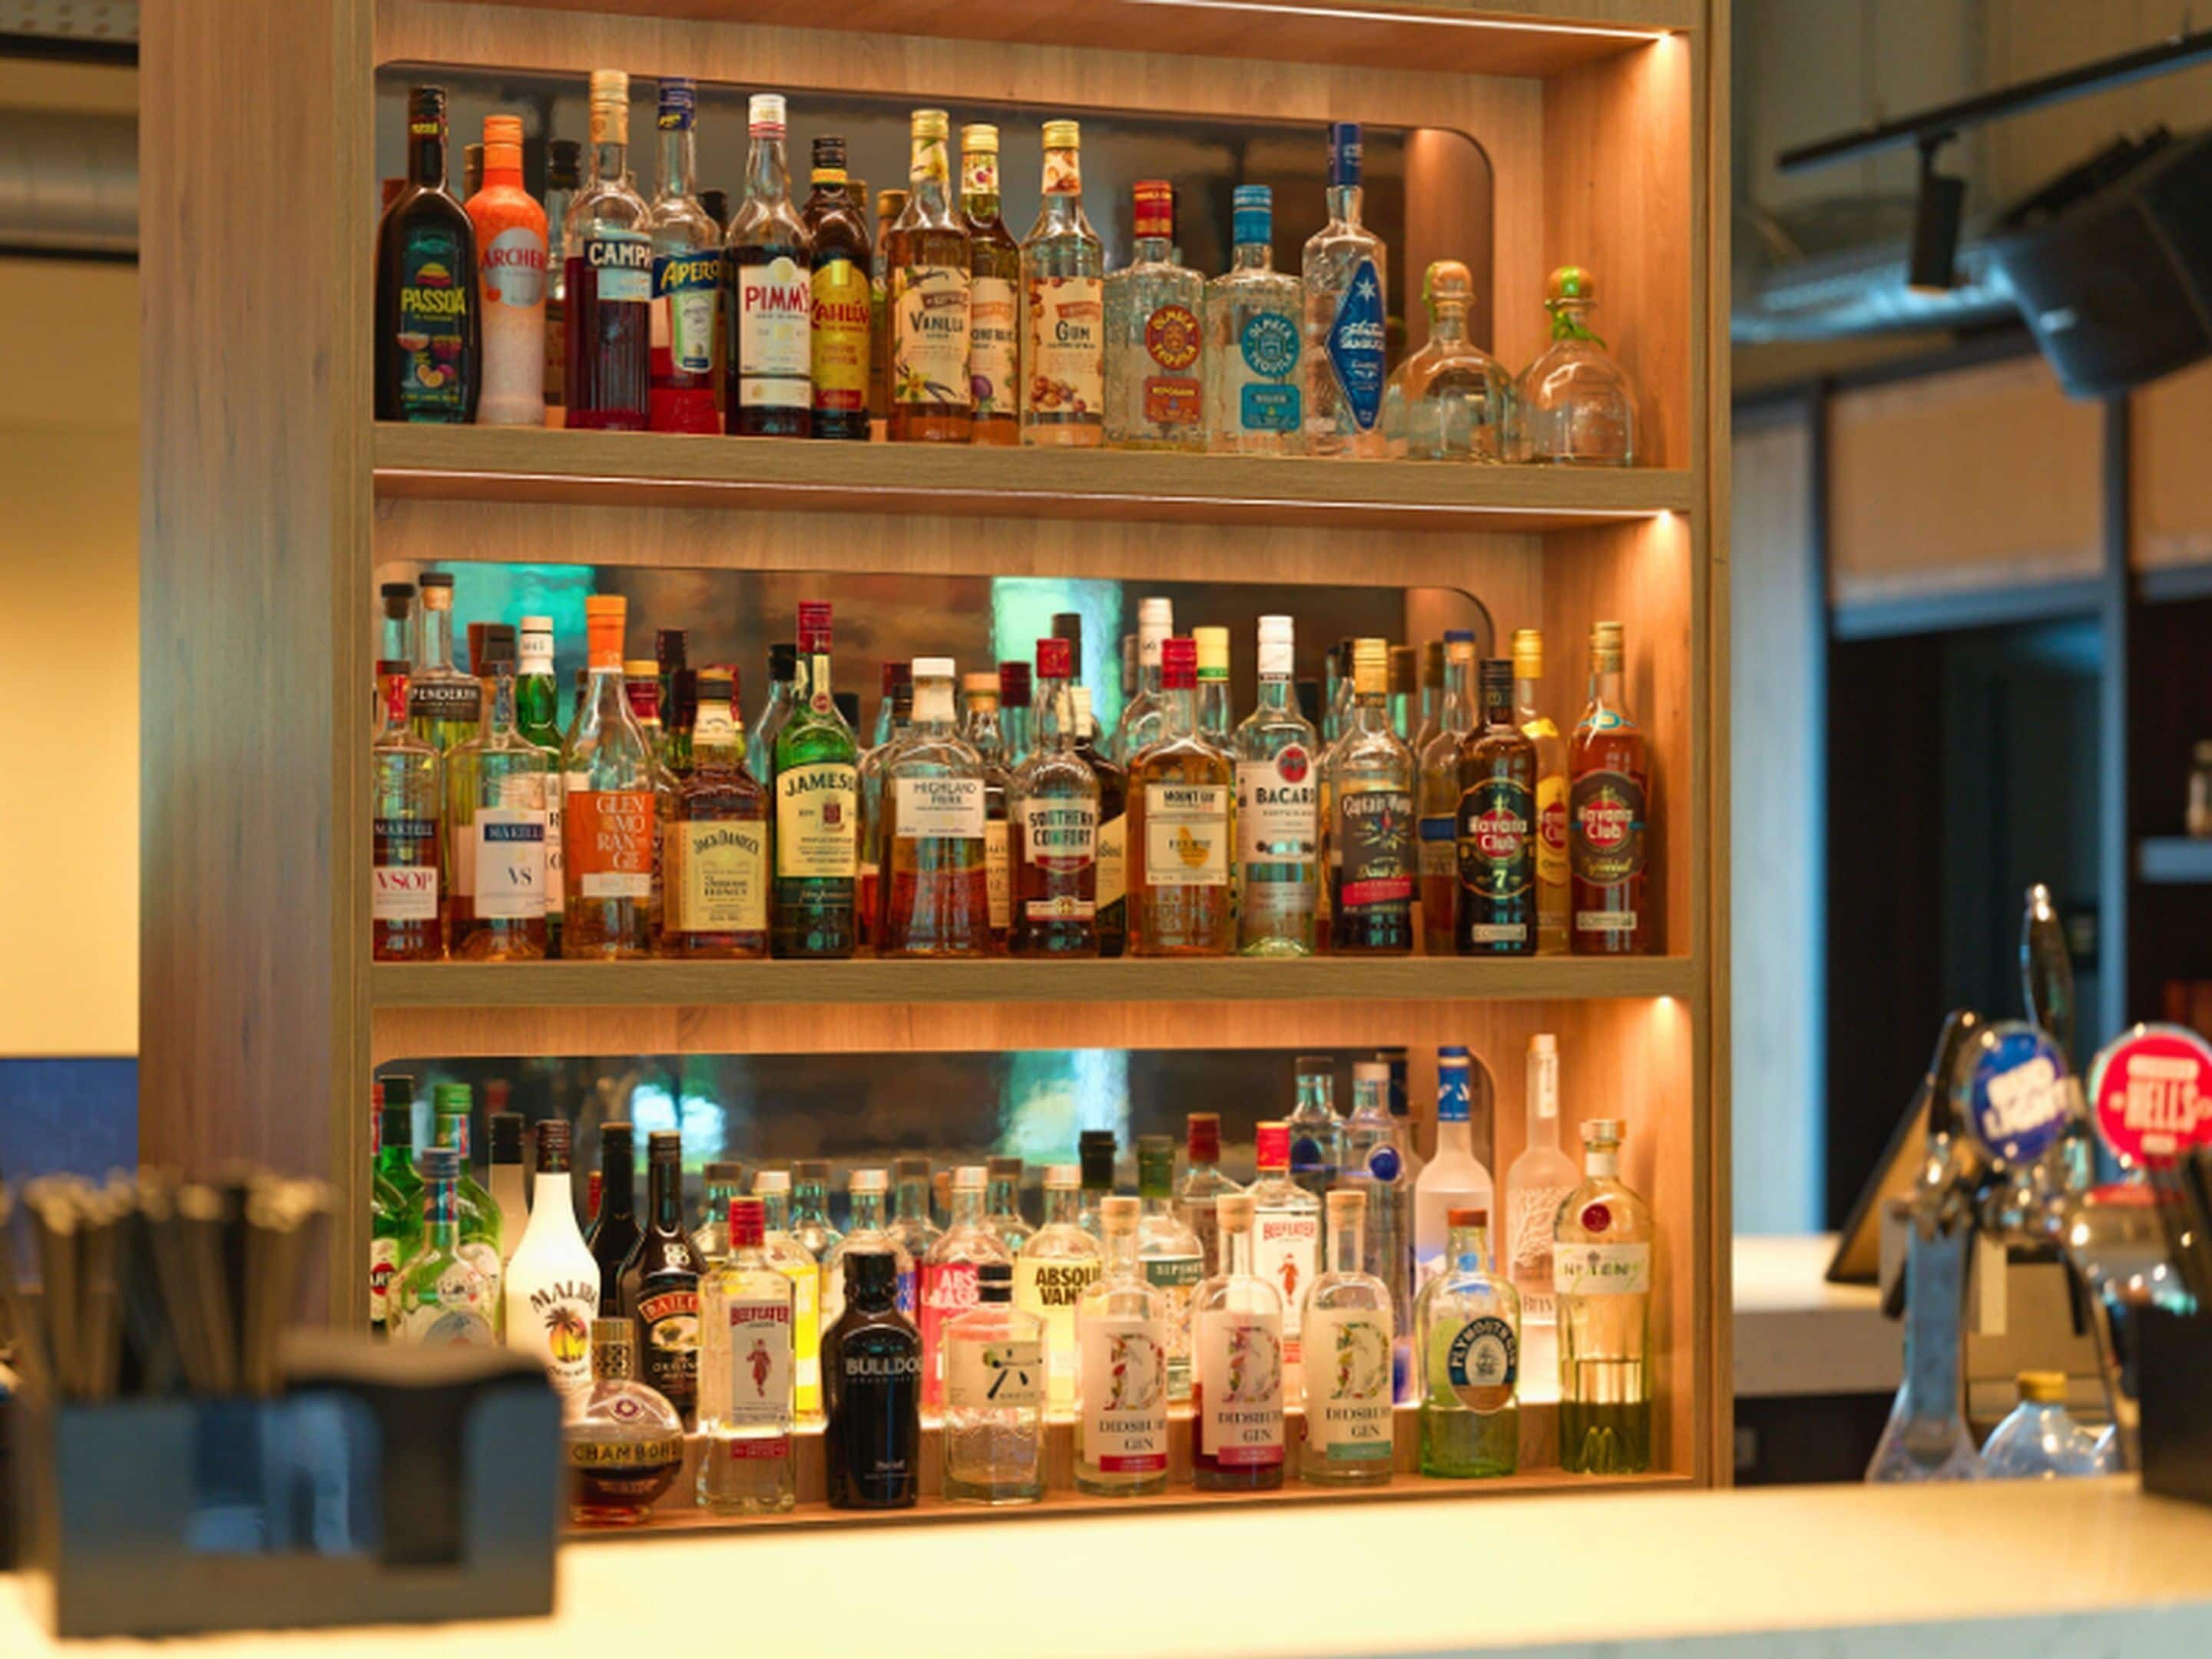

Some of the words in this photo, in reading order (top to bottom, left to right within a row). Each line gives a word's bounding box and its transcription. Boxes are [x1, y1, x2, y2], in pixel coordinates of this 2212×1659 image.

[507, 867, 533, 886] VS
[1492, 869, 1508, 888] 7
[1243, 1429, 1272, 1442] GIN
[1350, 1425, 1380, 1439] GIN
